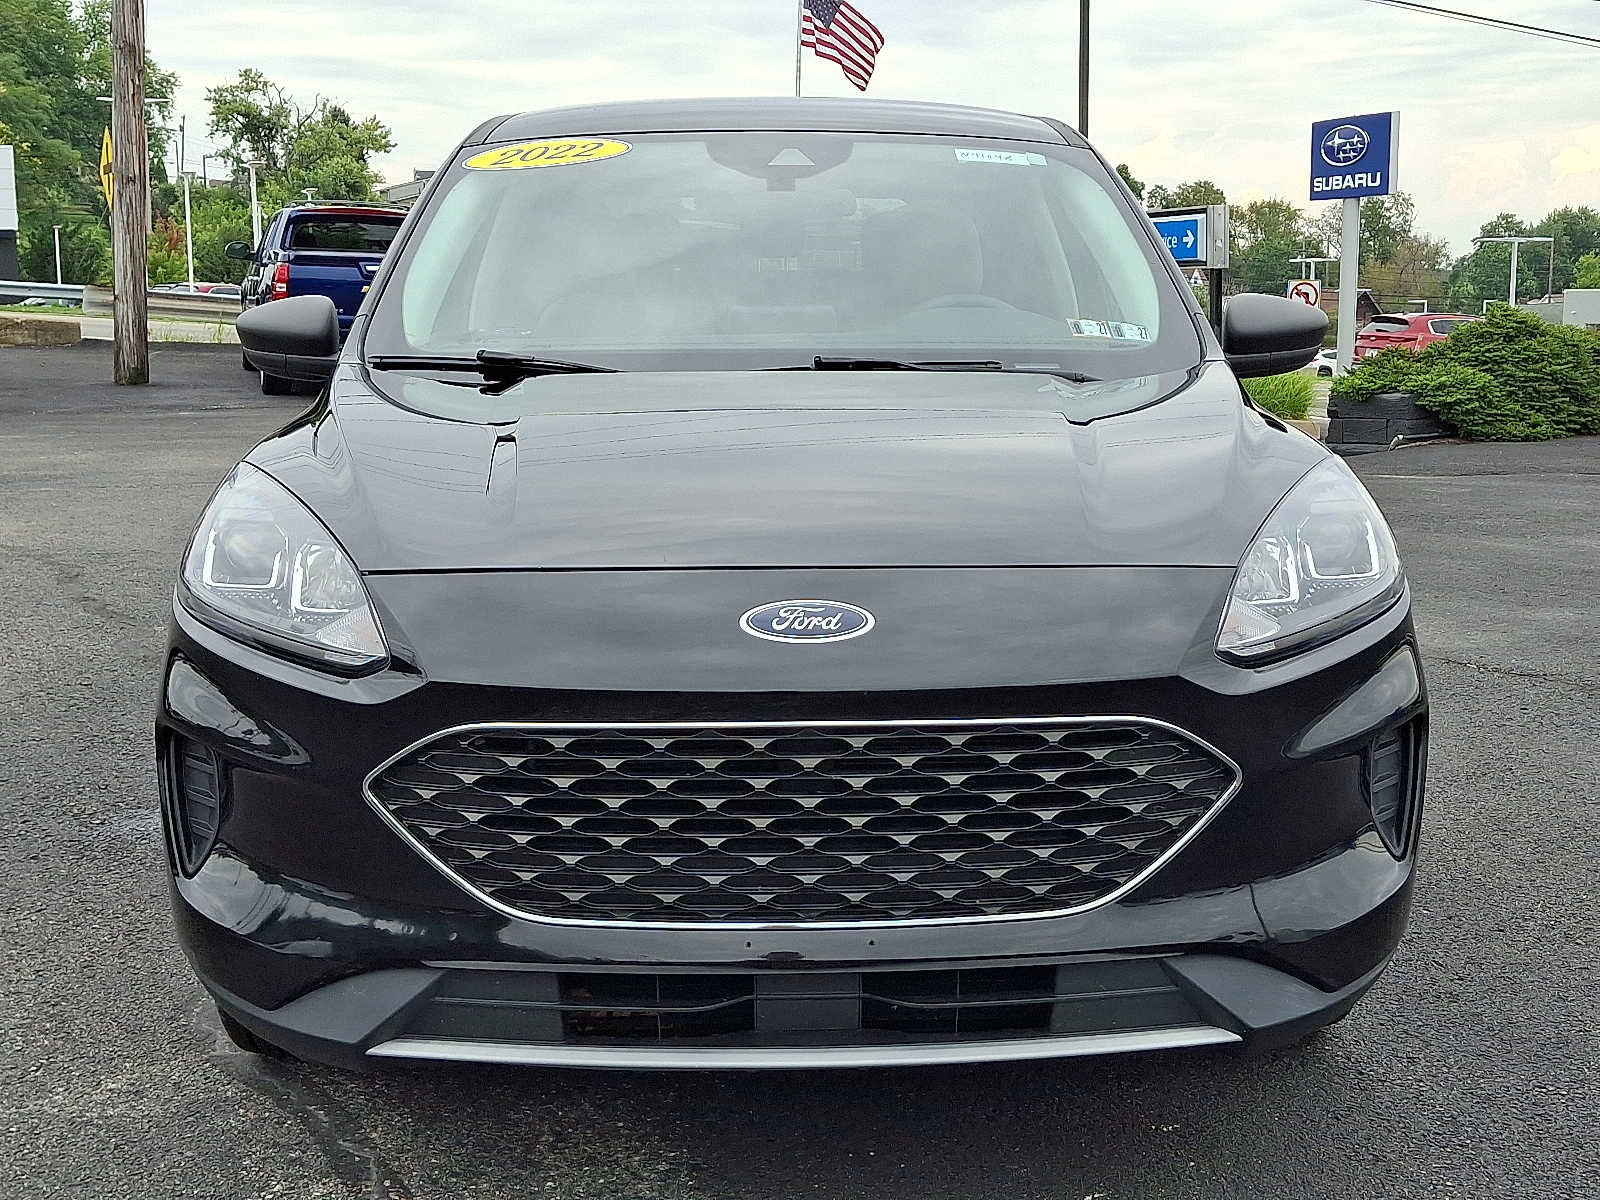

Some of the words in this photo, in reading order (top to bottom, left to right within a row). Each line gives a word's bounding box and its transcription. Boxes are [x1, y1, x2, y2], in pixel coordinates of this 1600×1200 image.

[490, 142, 604, 166] 2022
[1313, 171, 1381, 192] SUBARU
[771, 606, 843, 631] Ford
